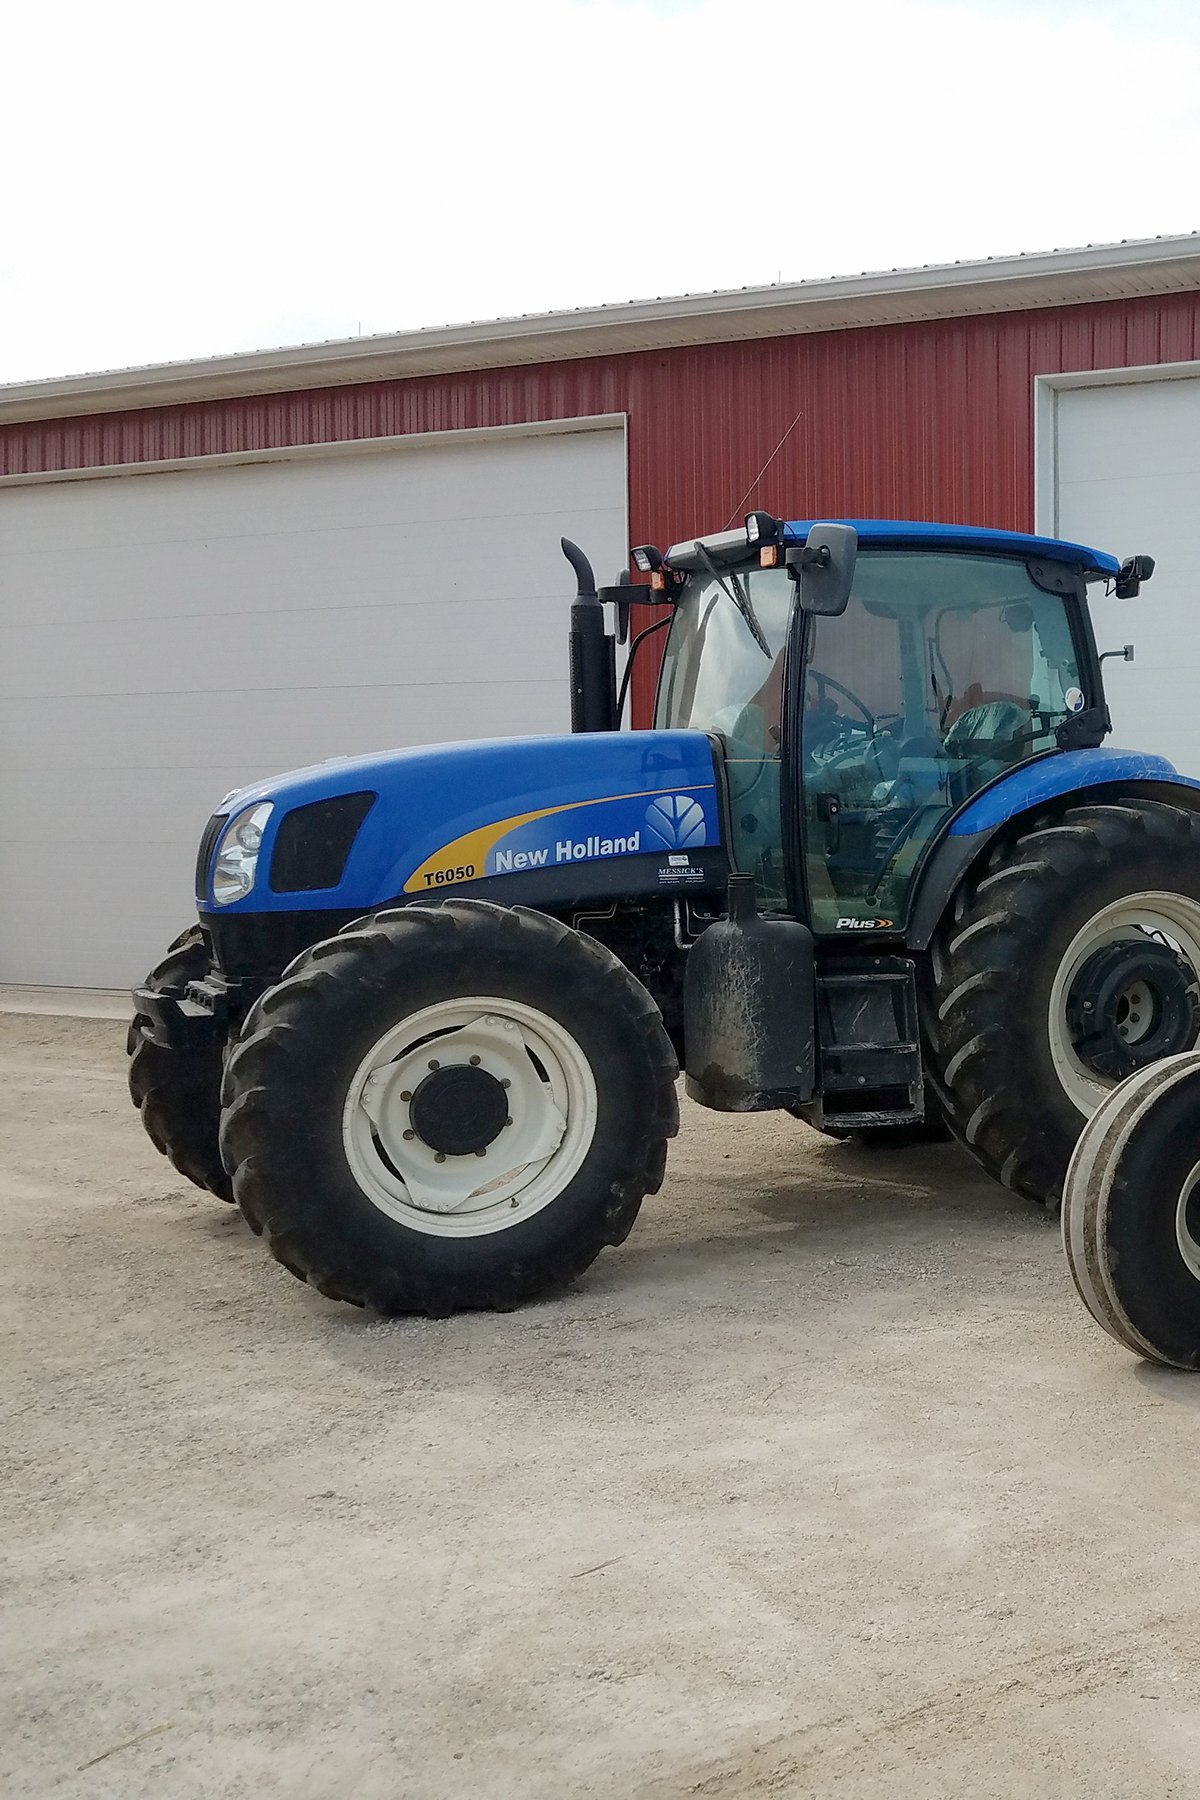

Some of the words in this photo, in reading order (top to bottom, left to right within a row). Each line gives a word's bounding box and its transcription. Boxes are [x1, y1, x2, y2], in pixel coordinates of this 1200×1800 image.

[495, 848, 548, 872] New
[555, 831, 640, 862] Holland
[423, 864, 475, 886] T6050
[658, 867, 704, 875] MESSICK'S
[836, 918, 875, 929] Plus
